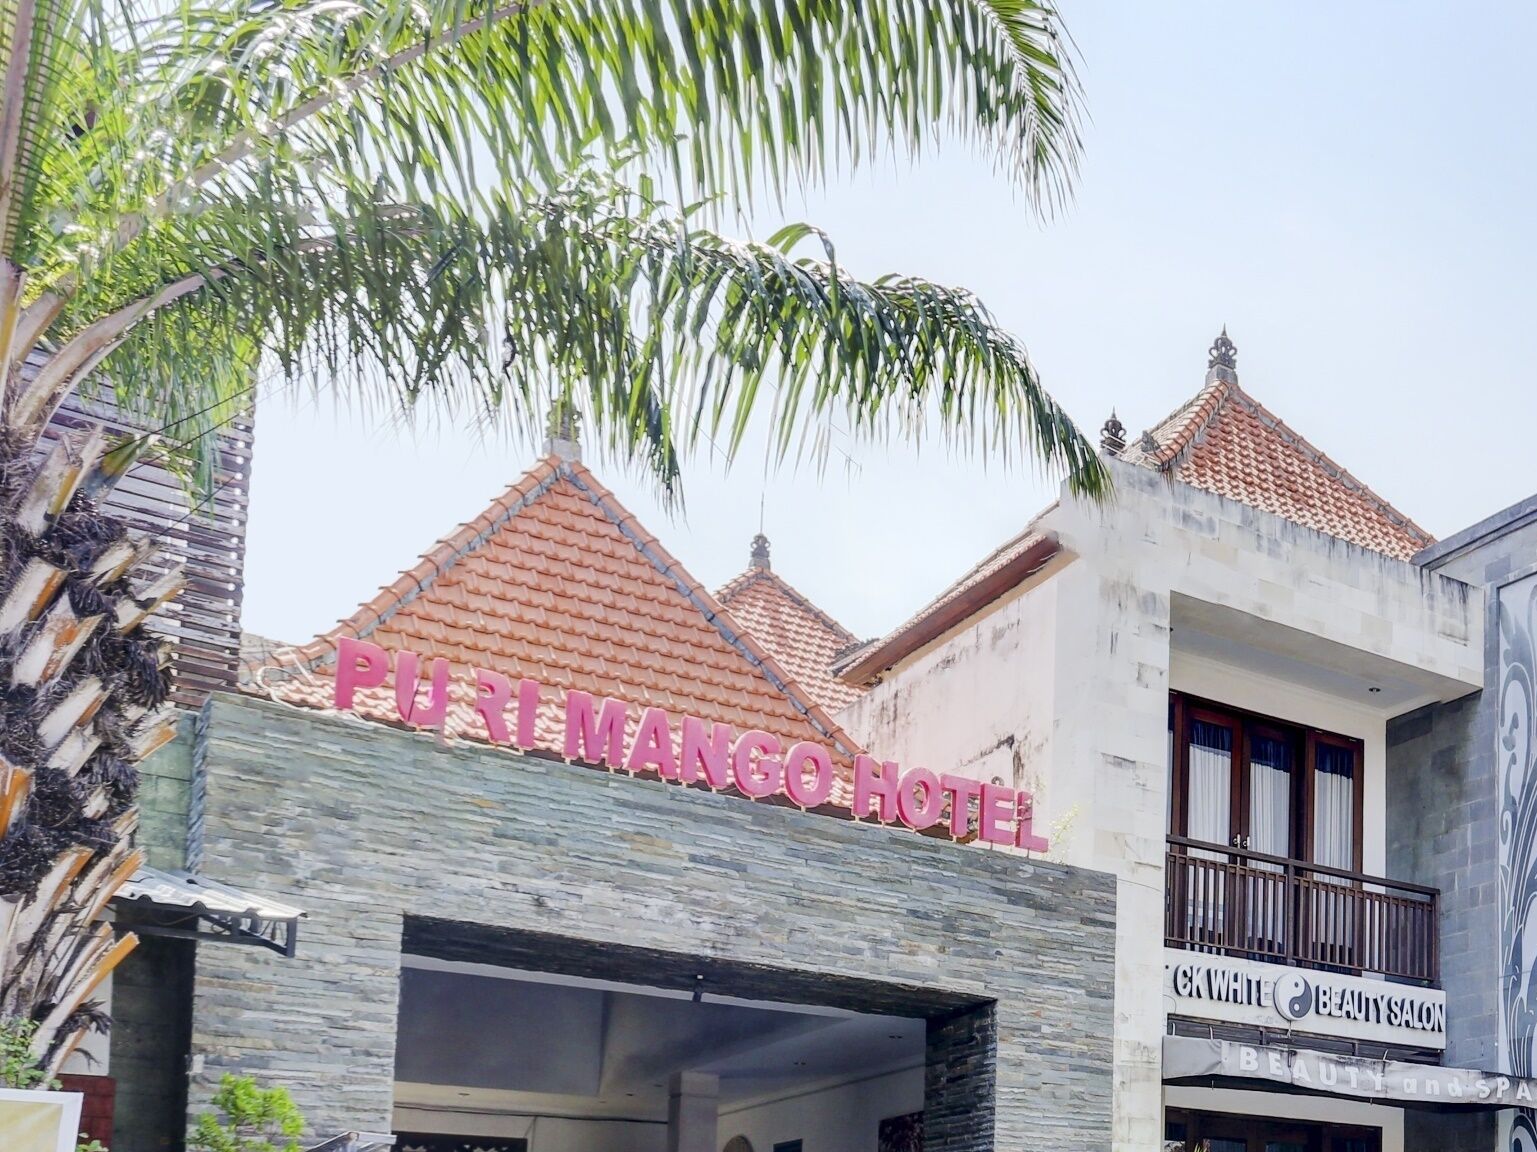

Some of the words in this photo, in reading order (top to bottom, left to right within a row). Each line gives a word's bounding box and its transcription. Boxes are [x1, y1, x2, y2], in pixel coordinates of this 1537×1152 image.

[335, 636, 539, 749] PURI
[564, 688, 834, 809] MANGO
[853, 753, 1049, 853] HOTEL
[1206, 967, 1275, 1008] WHITE
[1314, 984, 1389, 1025] BEAUTY
[1387, 996, 1444, 1033] SALON
[1238, 1047, 1386, 1092] BEAUTY
[1403, 1077, 1463, 1099] and
